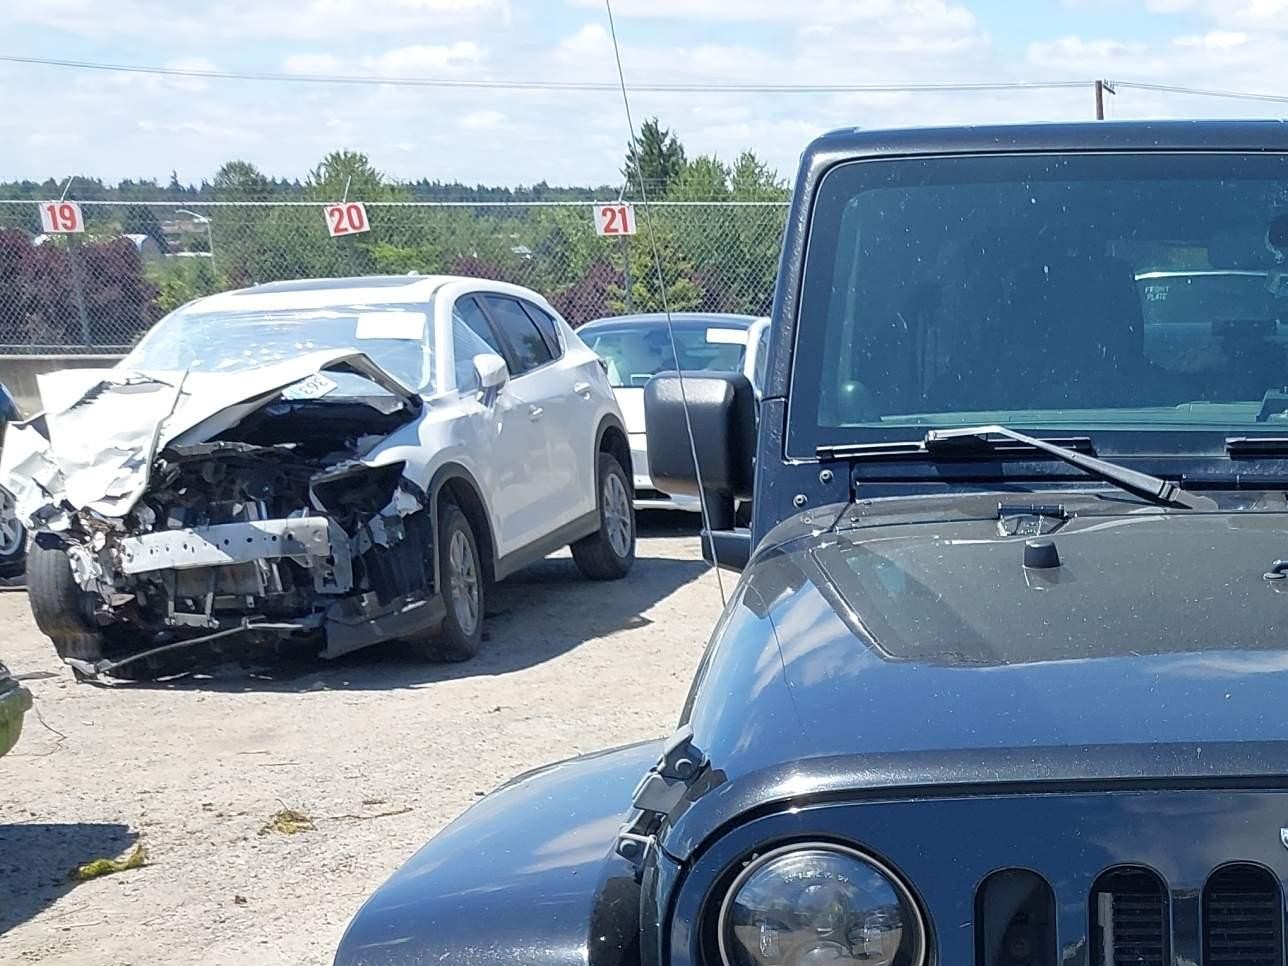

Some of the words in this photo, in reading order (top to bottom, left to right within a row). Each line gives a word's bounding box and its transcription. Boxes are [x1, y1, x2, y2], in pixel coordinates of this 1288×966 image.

[47, 204, 77, 231] 19
[330, 204, 364, 233] 20
[601, 207, 629, 233] 21
